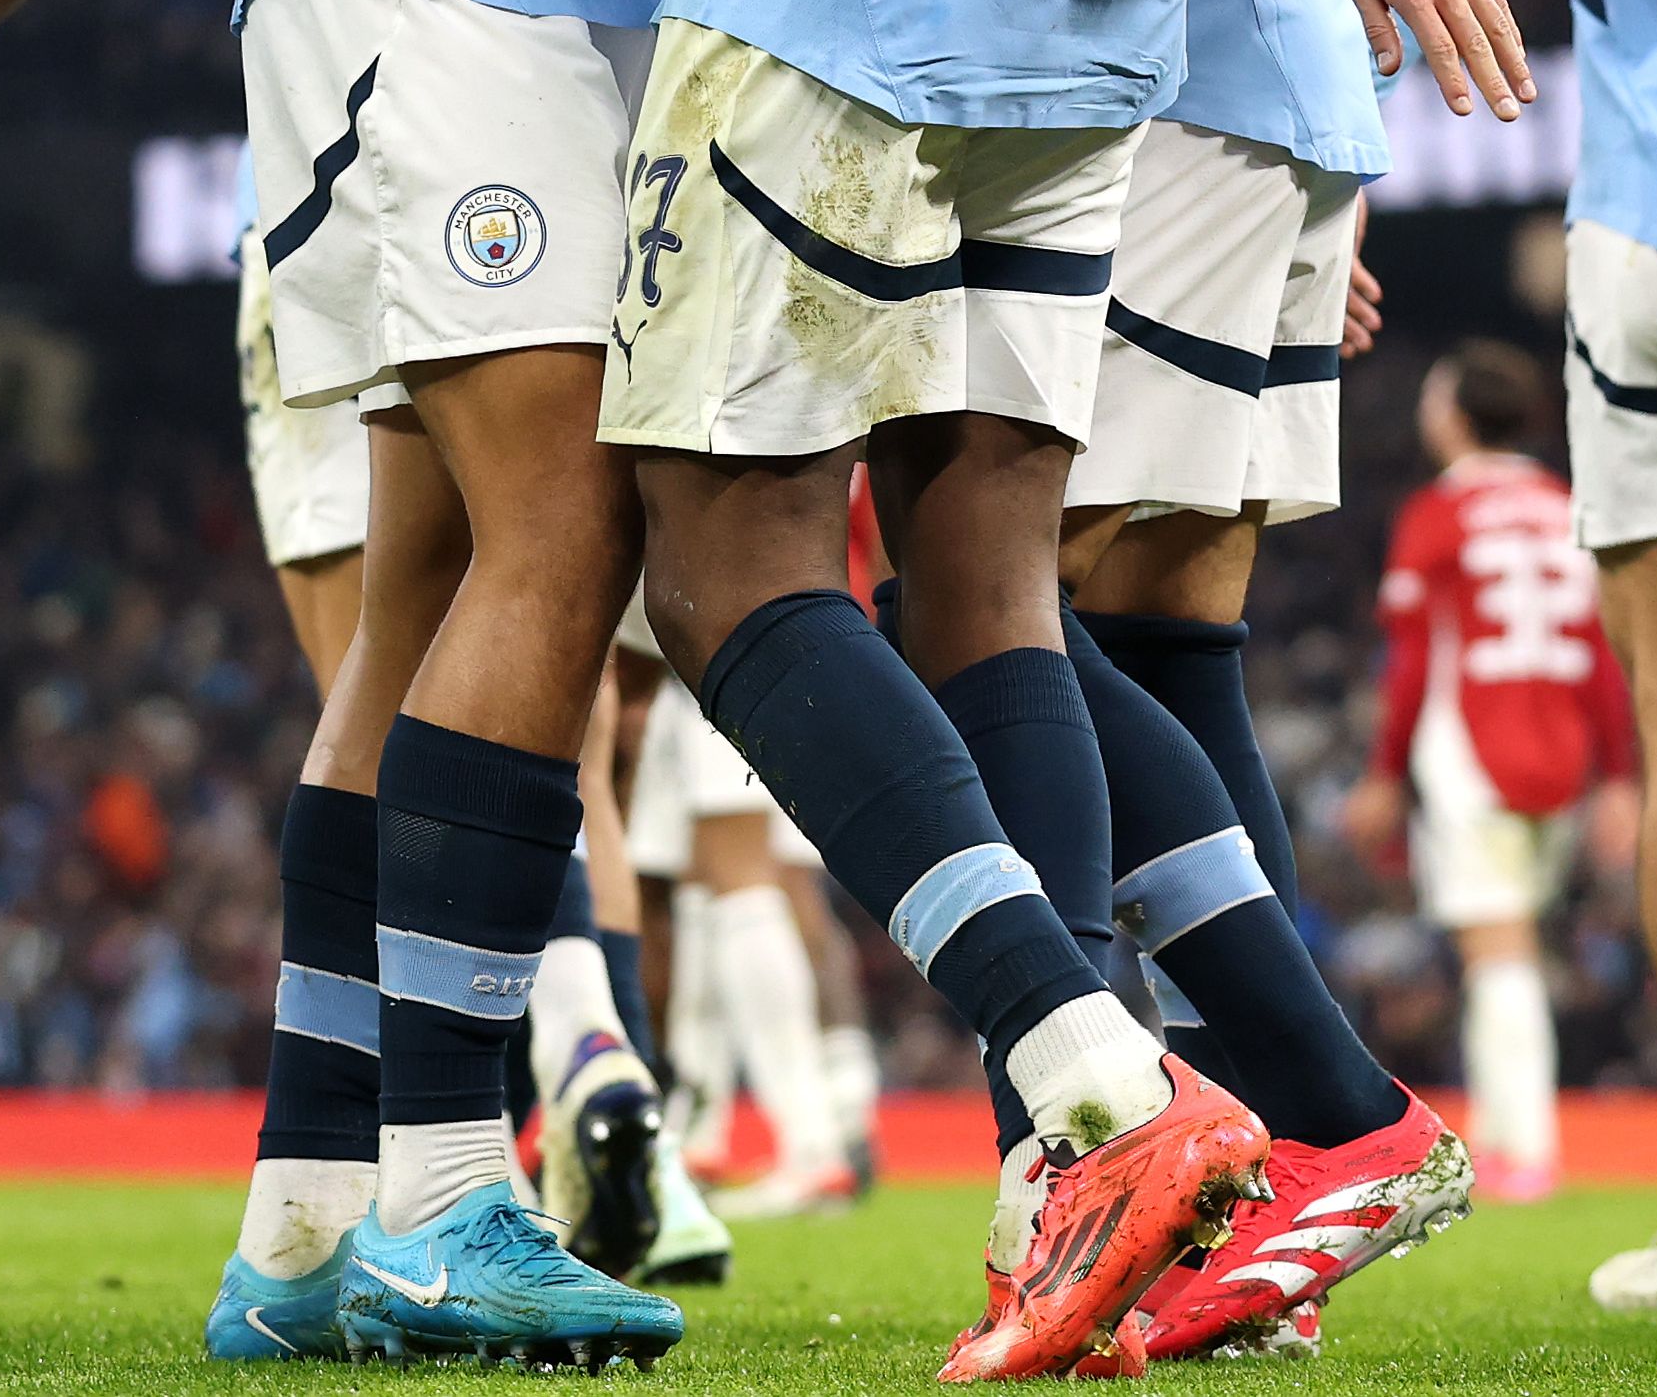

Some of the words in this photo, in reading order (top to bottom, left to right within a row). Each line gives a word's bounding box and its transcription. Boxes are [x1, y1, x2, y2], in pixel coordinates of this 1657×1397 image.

[454, 193, 532, 230] MANCHESTER
[486, 267, 515, 281] CITY
[470, 974, 536, 996] CIT
